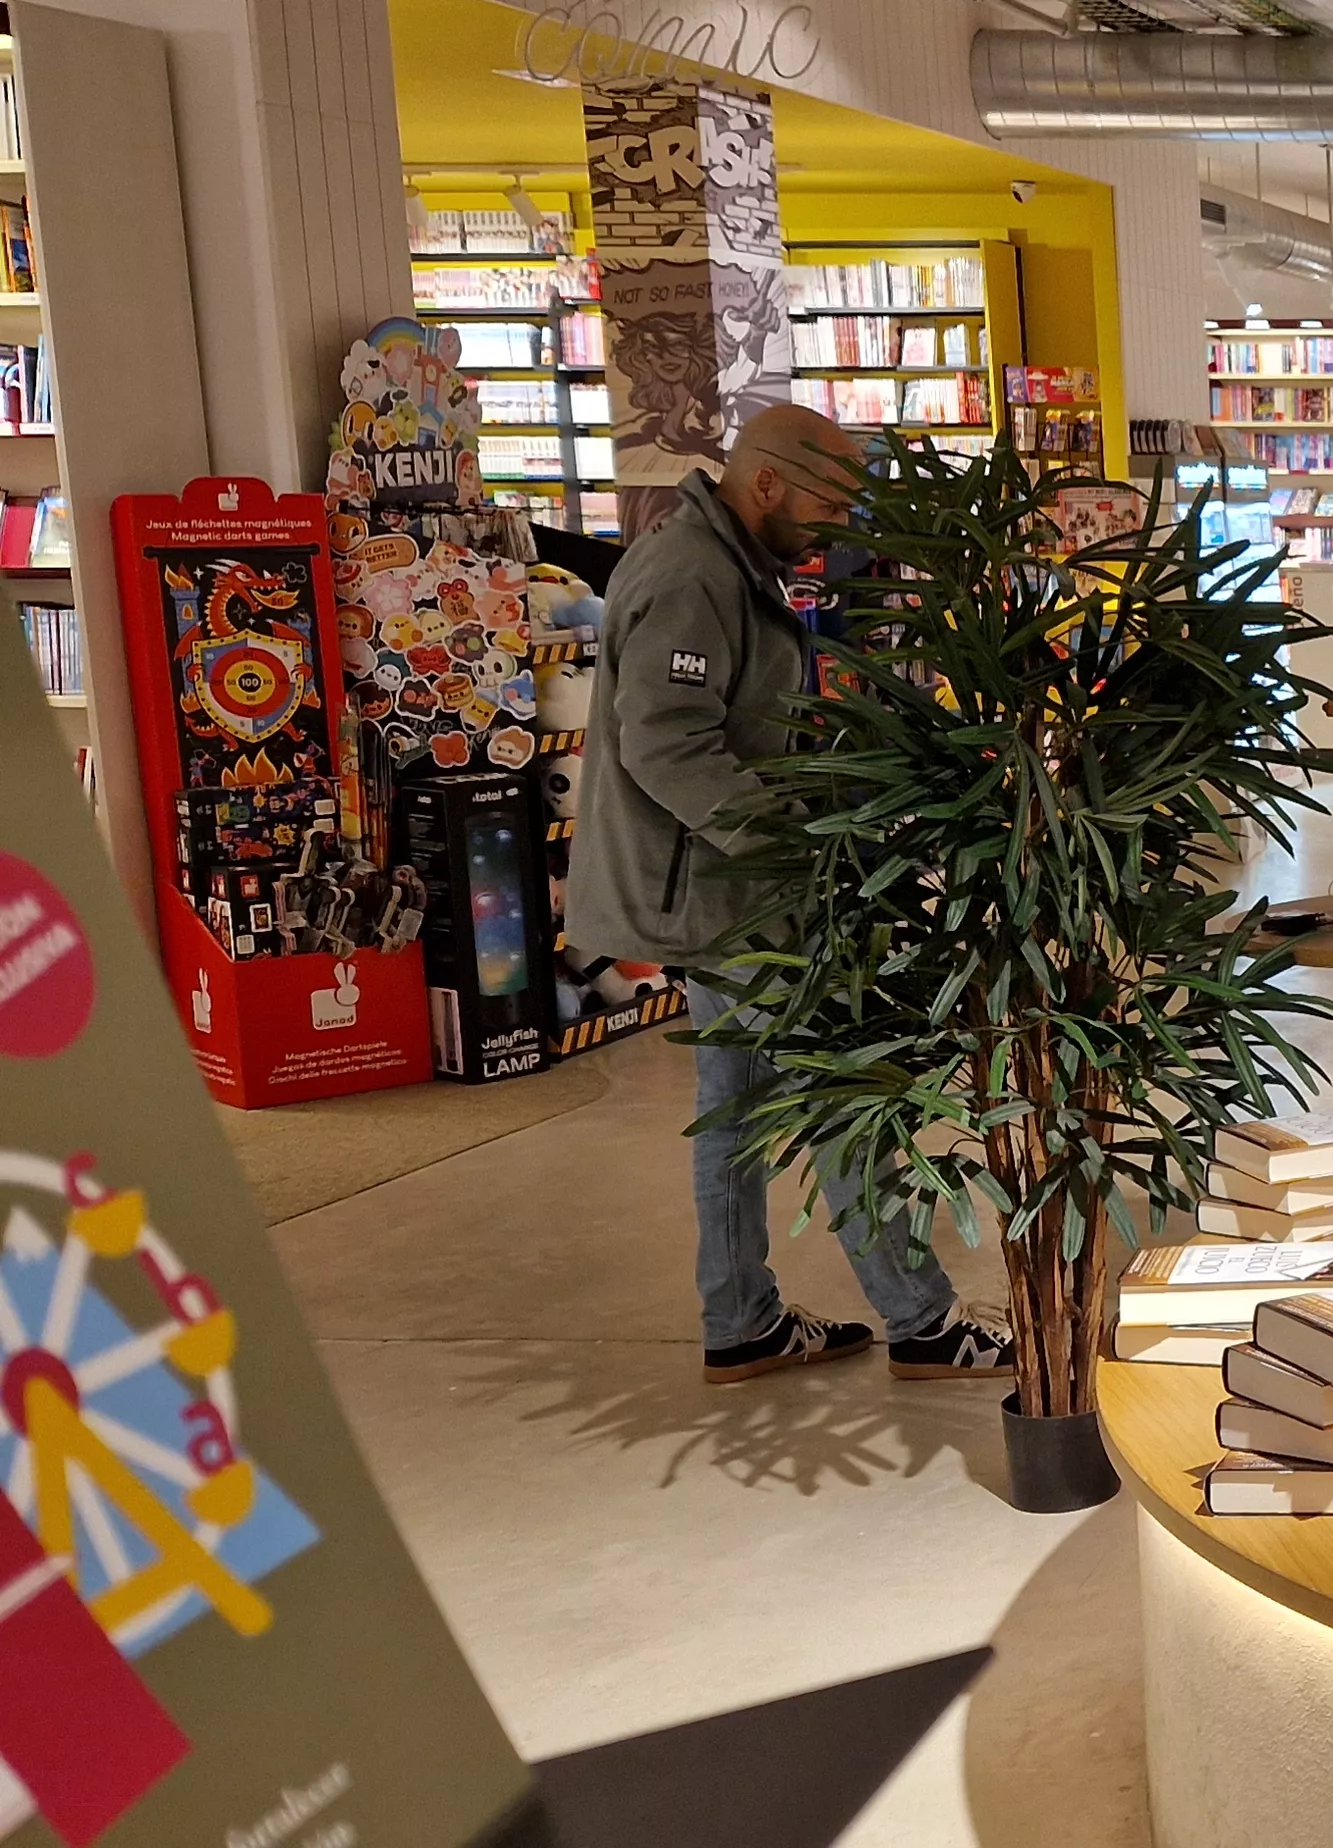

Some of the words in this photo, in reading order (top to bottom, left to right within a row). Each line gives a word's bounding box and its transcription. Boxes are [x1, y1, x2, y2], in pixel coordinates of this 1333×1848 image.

[614, 286, 643, 305] NOT
[651, 284, 669, 301] SO
[674, 282, 713, 300] FAST
[374, 451, 453, 489] KENJI
[145, 518, 173, 530] Jeux
[175, 519, 188, 529] de
[191, 517, 243, 530] fléchettes
[244, 517, 312, 533] magnétiques
[171, 530, 222, 545] Magnetic
[223, 530, 252, 542] darts
[255, 532, 290, 543] games
[671, 652, 706, 674] HH
[241, 678, 260, 688] 100
[606, 1007, 638, 1033] KENJI
[481, 1026, 539, 1051] Jellyfish
[483, 1052, 541, 1079] LAMP
